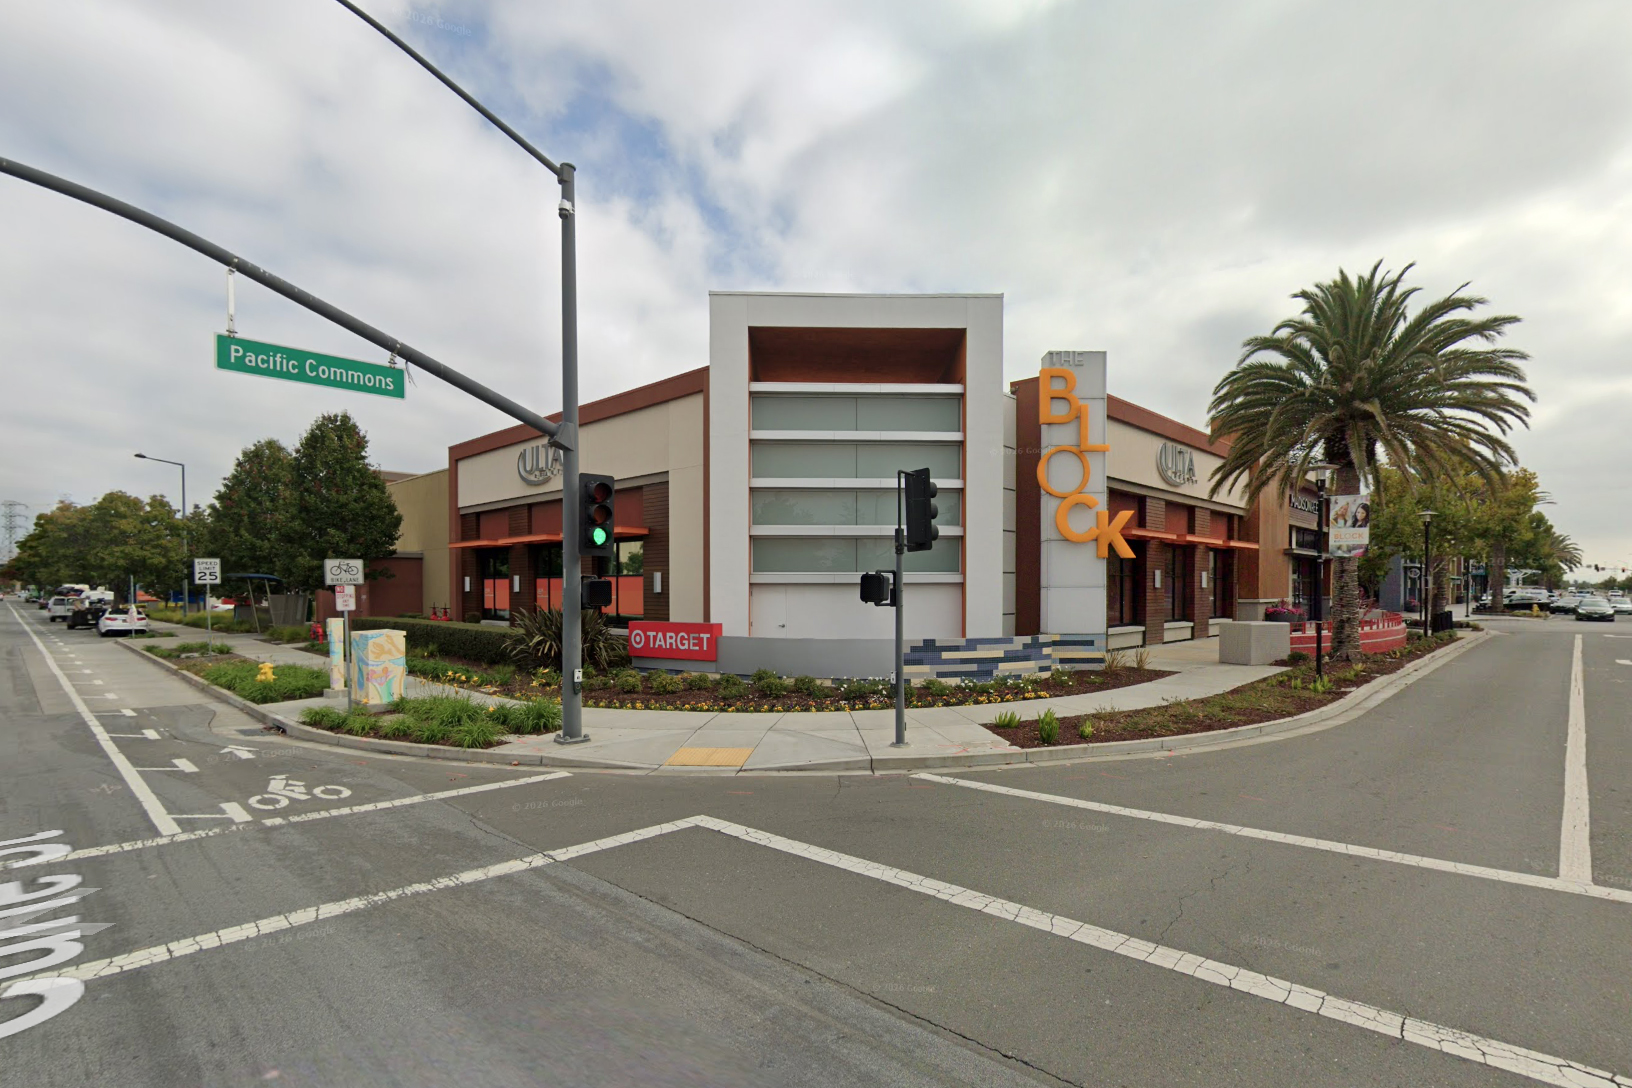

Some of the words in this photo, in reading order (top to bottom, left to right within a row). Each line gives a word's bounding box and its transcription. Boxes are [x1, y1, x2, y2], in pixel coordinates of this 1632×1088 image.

[229, 345, 298, 372] Pacific
[305, 359, 394, 388] Commons
[1049, 350, 1084, 366] THE
[520, 443, 563, 476] ULTA
[1037, 368, 1136, 559] BLOCK
[1158, 442, 1196, 479] ULTA
[1334, 532, 1363, 540] BLOCK
[197, 571, 218, 581] 25
[646, 631, 711, 651] TARGET
